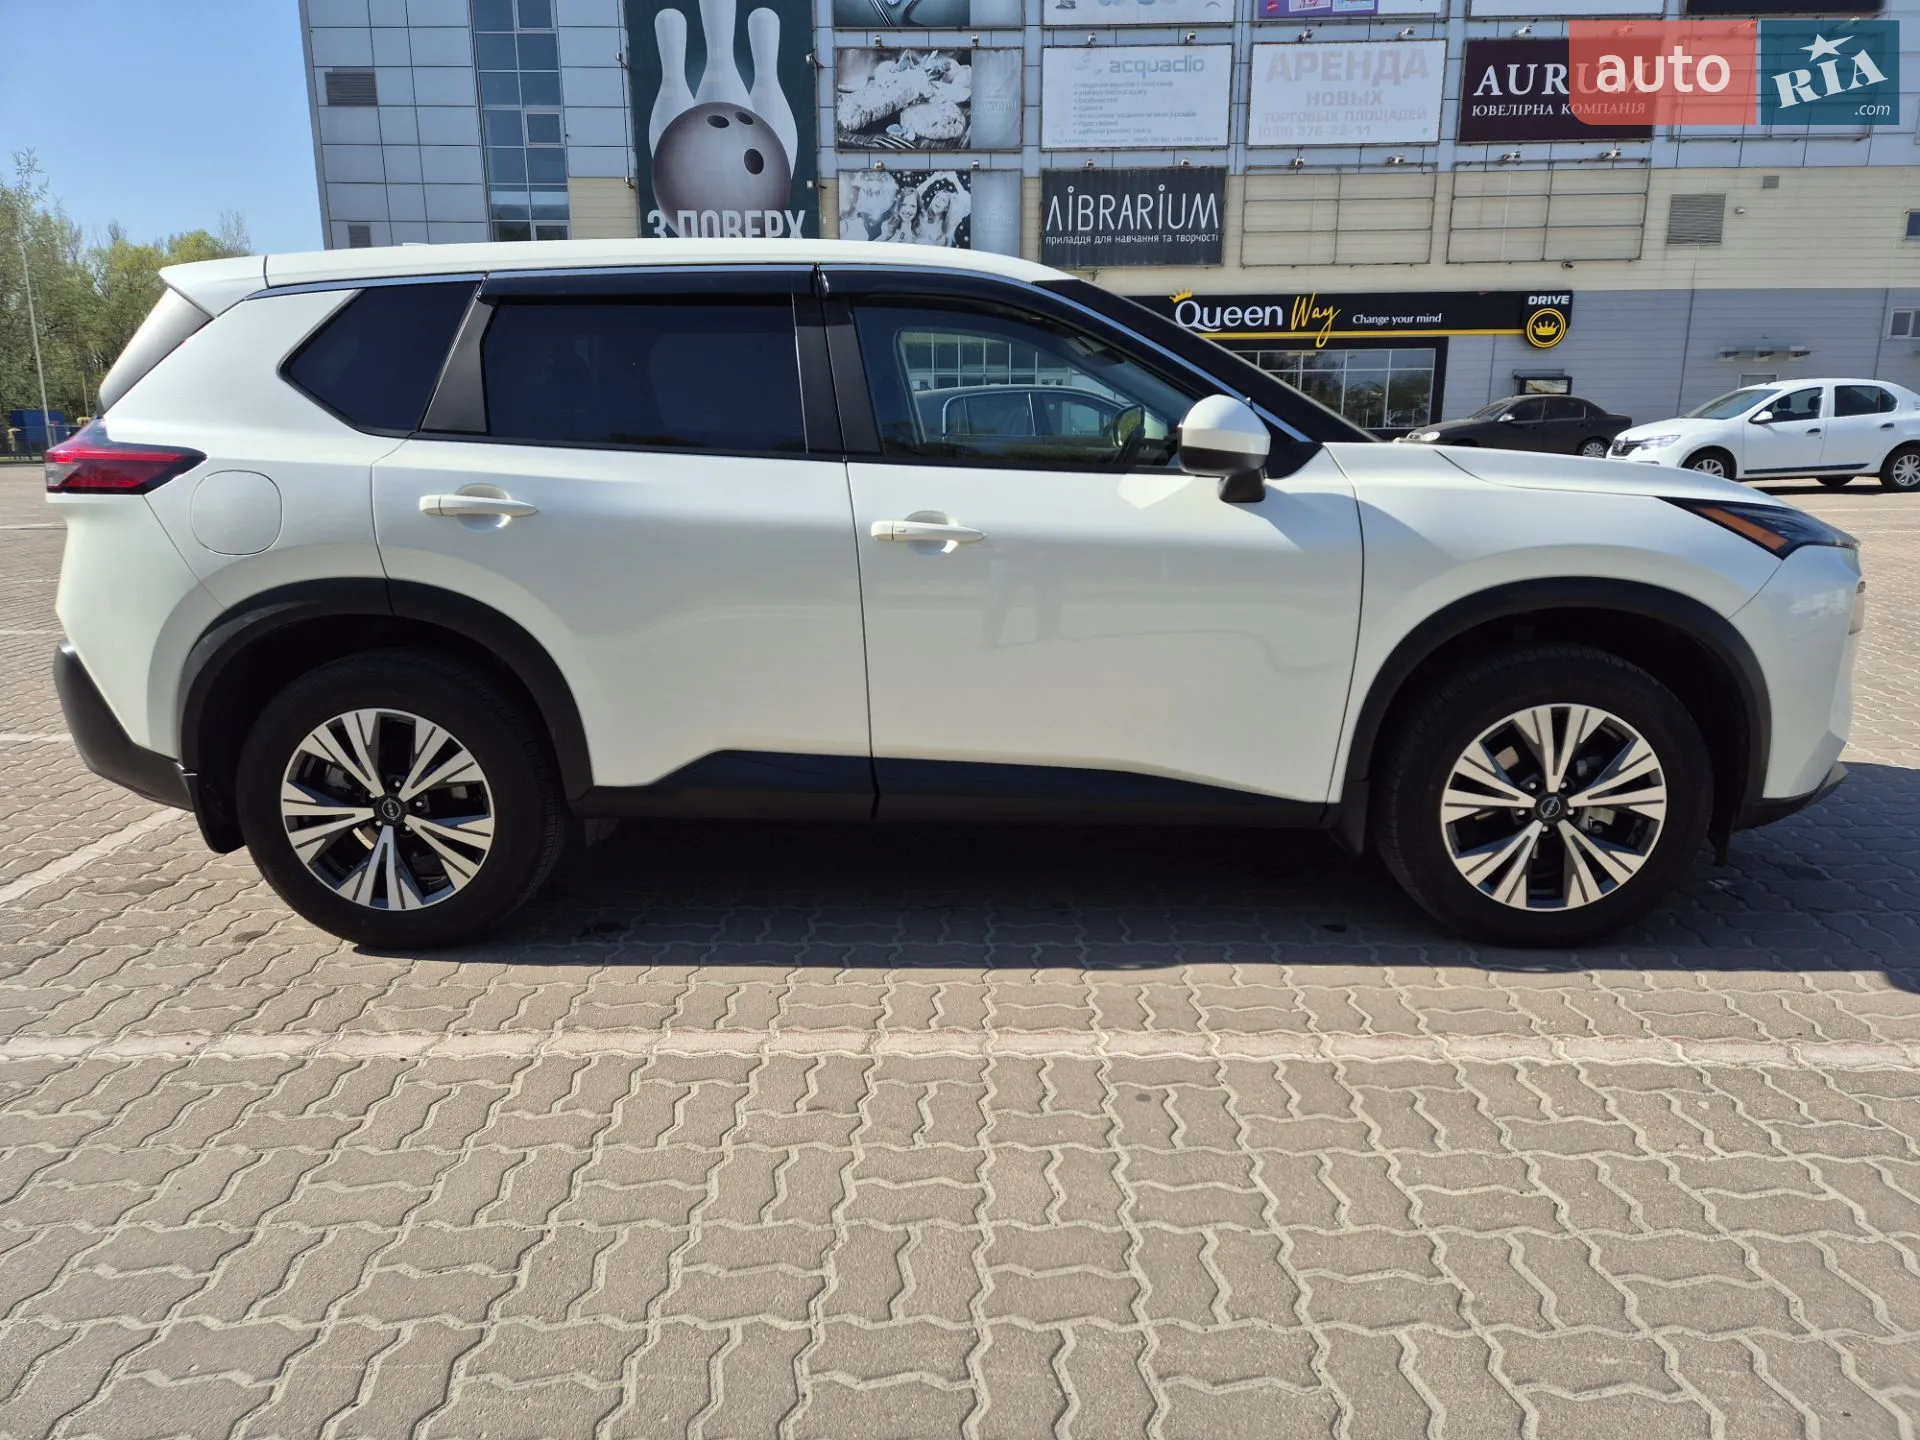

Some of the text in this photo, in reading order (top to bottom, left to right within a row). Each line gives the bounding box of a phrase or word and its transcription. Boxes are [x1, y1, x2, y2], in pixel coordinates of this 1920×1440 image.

[1266, 48, 1430, 87] АРЕНДА
[1306, 90, 1384, 107] НОВЫХ
[1471, 102, 1647, 117] ЮВЕЛІРНА КОМПАНІЯ
[1045, 233, 1219, 247] приладдя для навчання та творчості
[1528, 295, 1570, 305] DRIVE
[1175, 288, 1442, 348] Queen Way Change your mind
